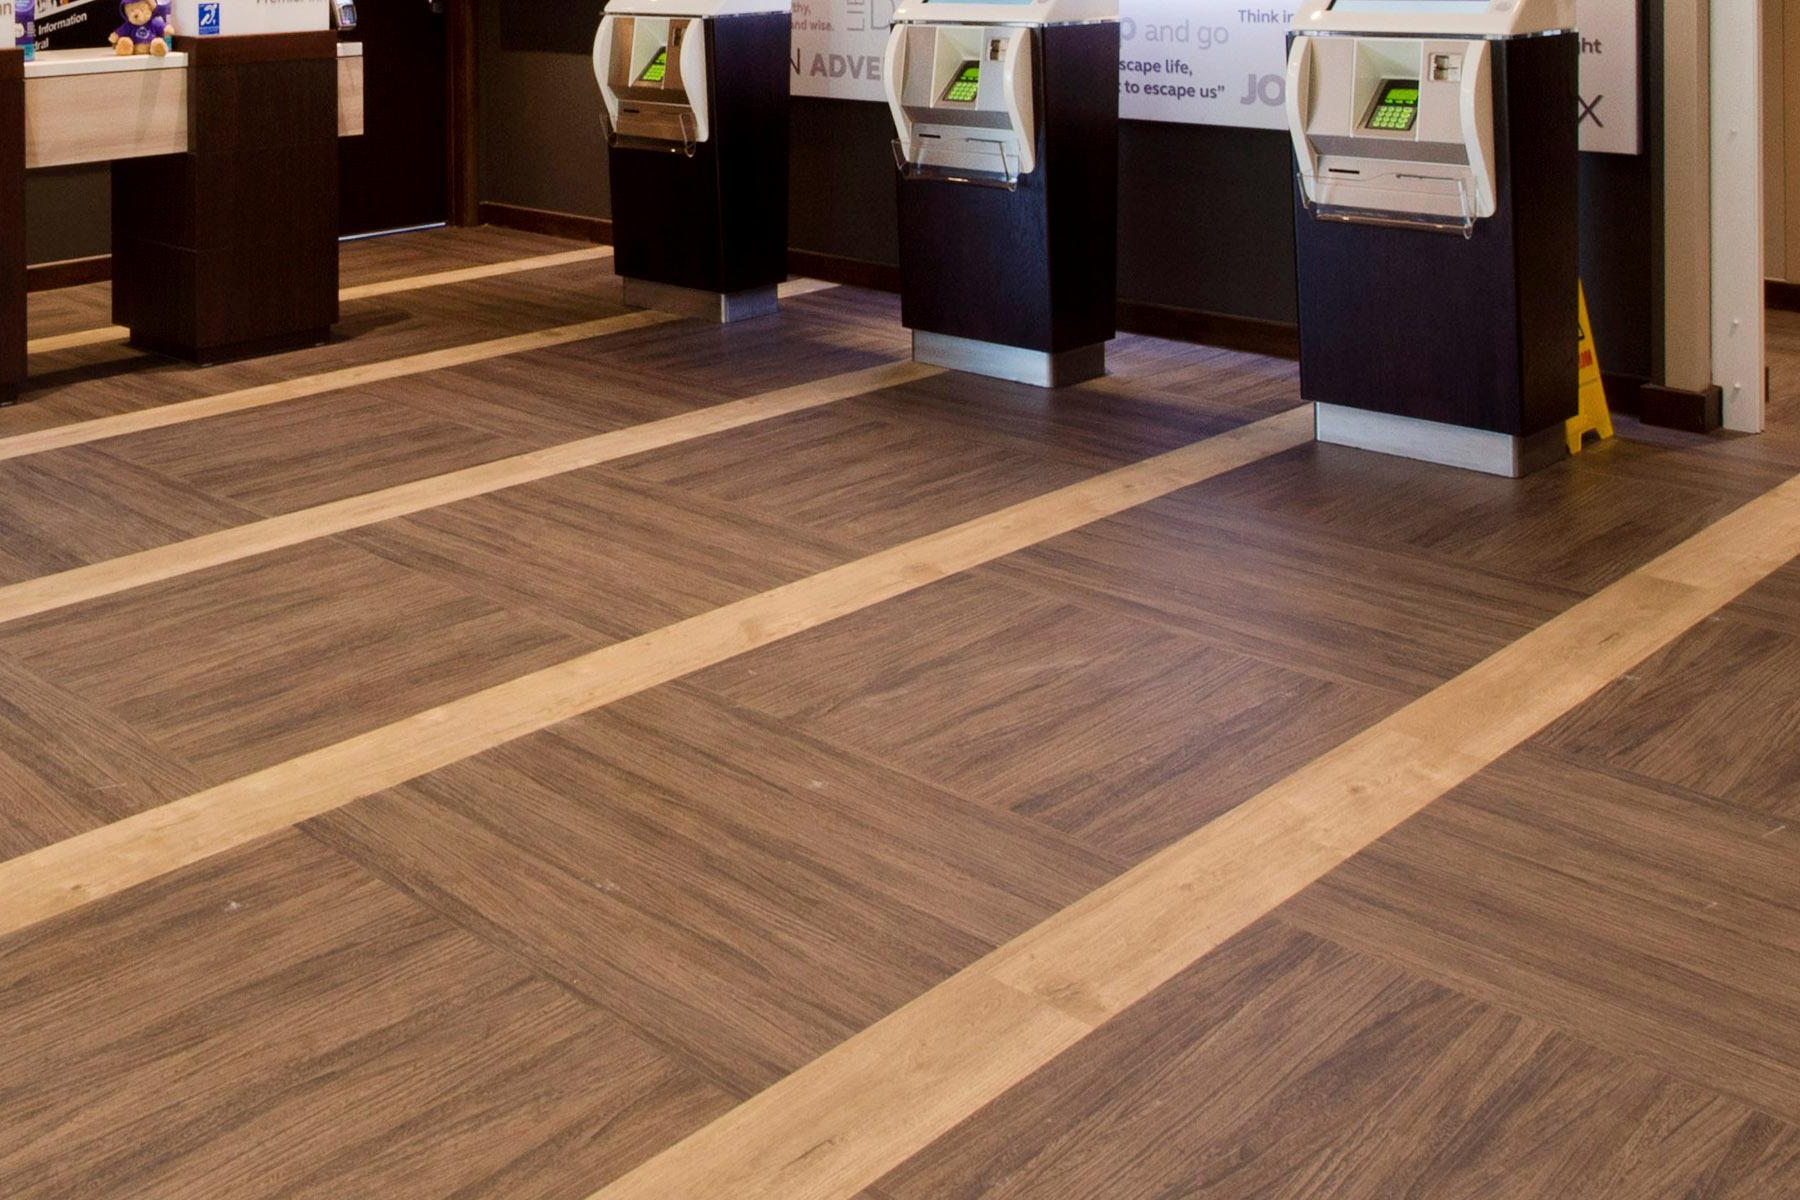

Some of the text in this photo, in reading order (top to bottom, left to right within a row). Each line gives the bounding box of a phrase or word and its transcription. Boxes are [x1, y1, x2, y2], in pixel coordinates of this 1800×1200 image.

[37, 11, 88, 36] Information
[810, 20, 833, 31] wise.
[1238, 8, 1279, 24] Think
[1144, 19, 1190, 43] and
[1197, 25, 1229, 50] go
[1119, 58, 1193, 80] scape life,
[1124, 80, 1140, 94] to
[1143, 82, 1196, 101] escape
[1199, 84, 1225, 99] us”
